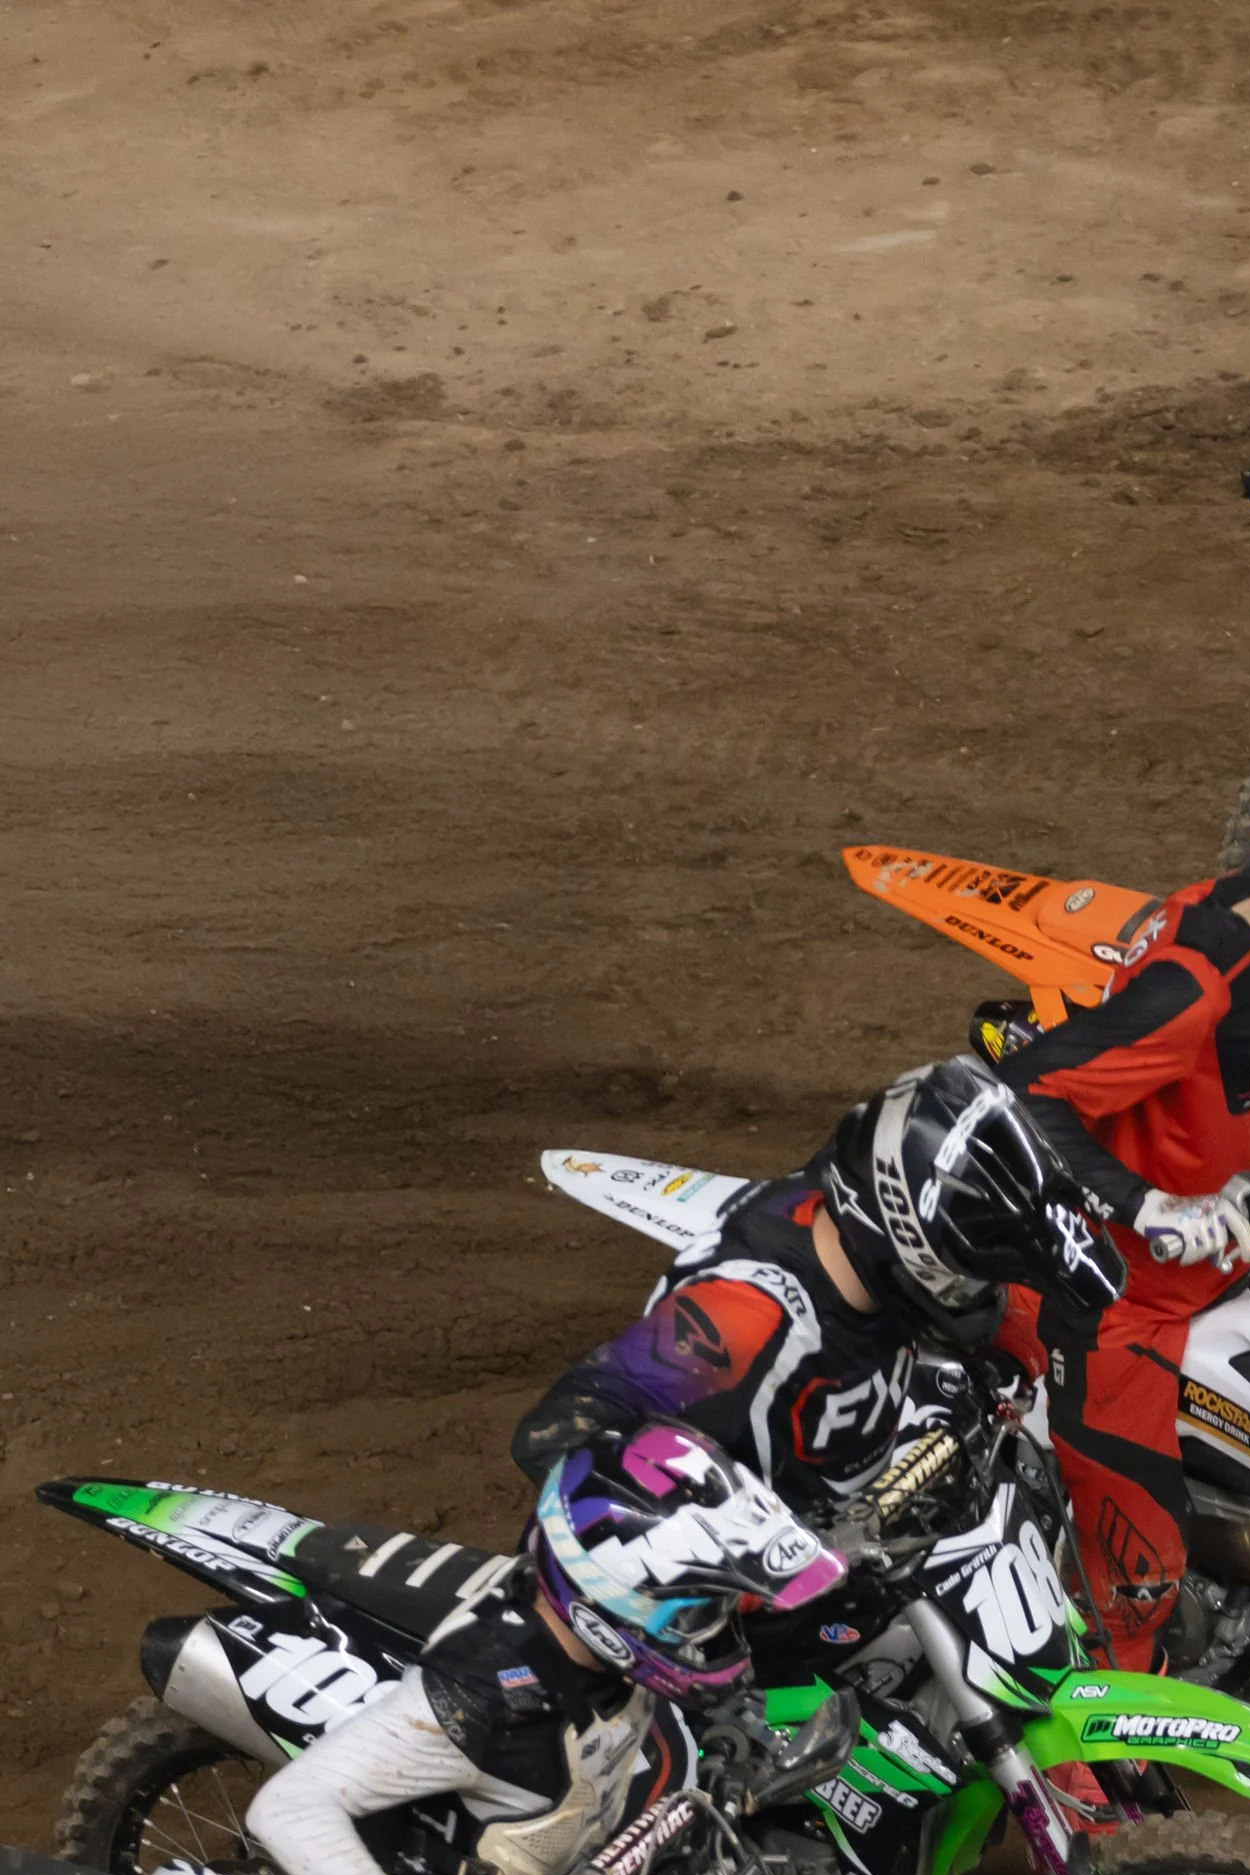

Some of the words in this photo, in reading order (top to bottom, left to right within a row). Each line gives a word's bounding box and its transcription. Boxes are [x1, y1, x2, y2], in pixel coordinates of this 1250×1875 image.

[944, 914, 1035, 961] DUNLOP
[617, 1199, 695, 1239] DUNLOP
[874, 1155, 936, 1282] 100%
[751, 1267, 808, 1317] FXR
[1189, 1403, 1224, 1432] ENERGY
[1222, 1421, 1250, 1446] DRINK
[106, 1516, 236, 1572] DUNLOP
[963, 1519, 1066, 1665] 108
[1071, 1683, 1110, 1700] ASV
